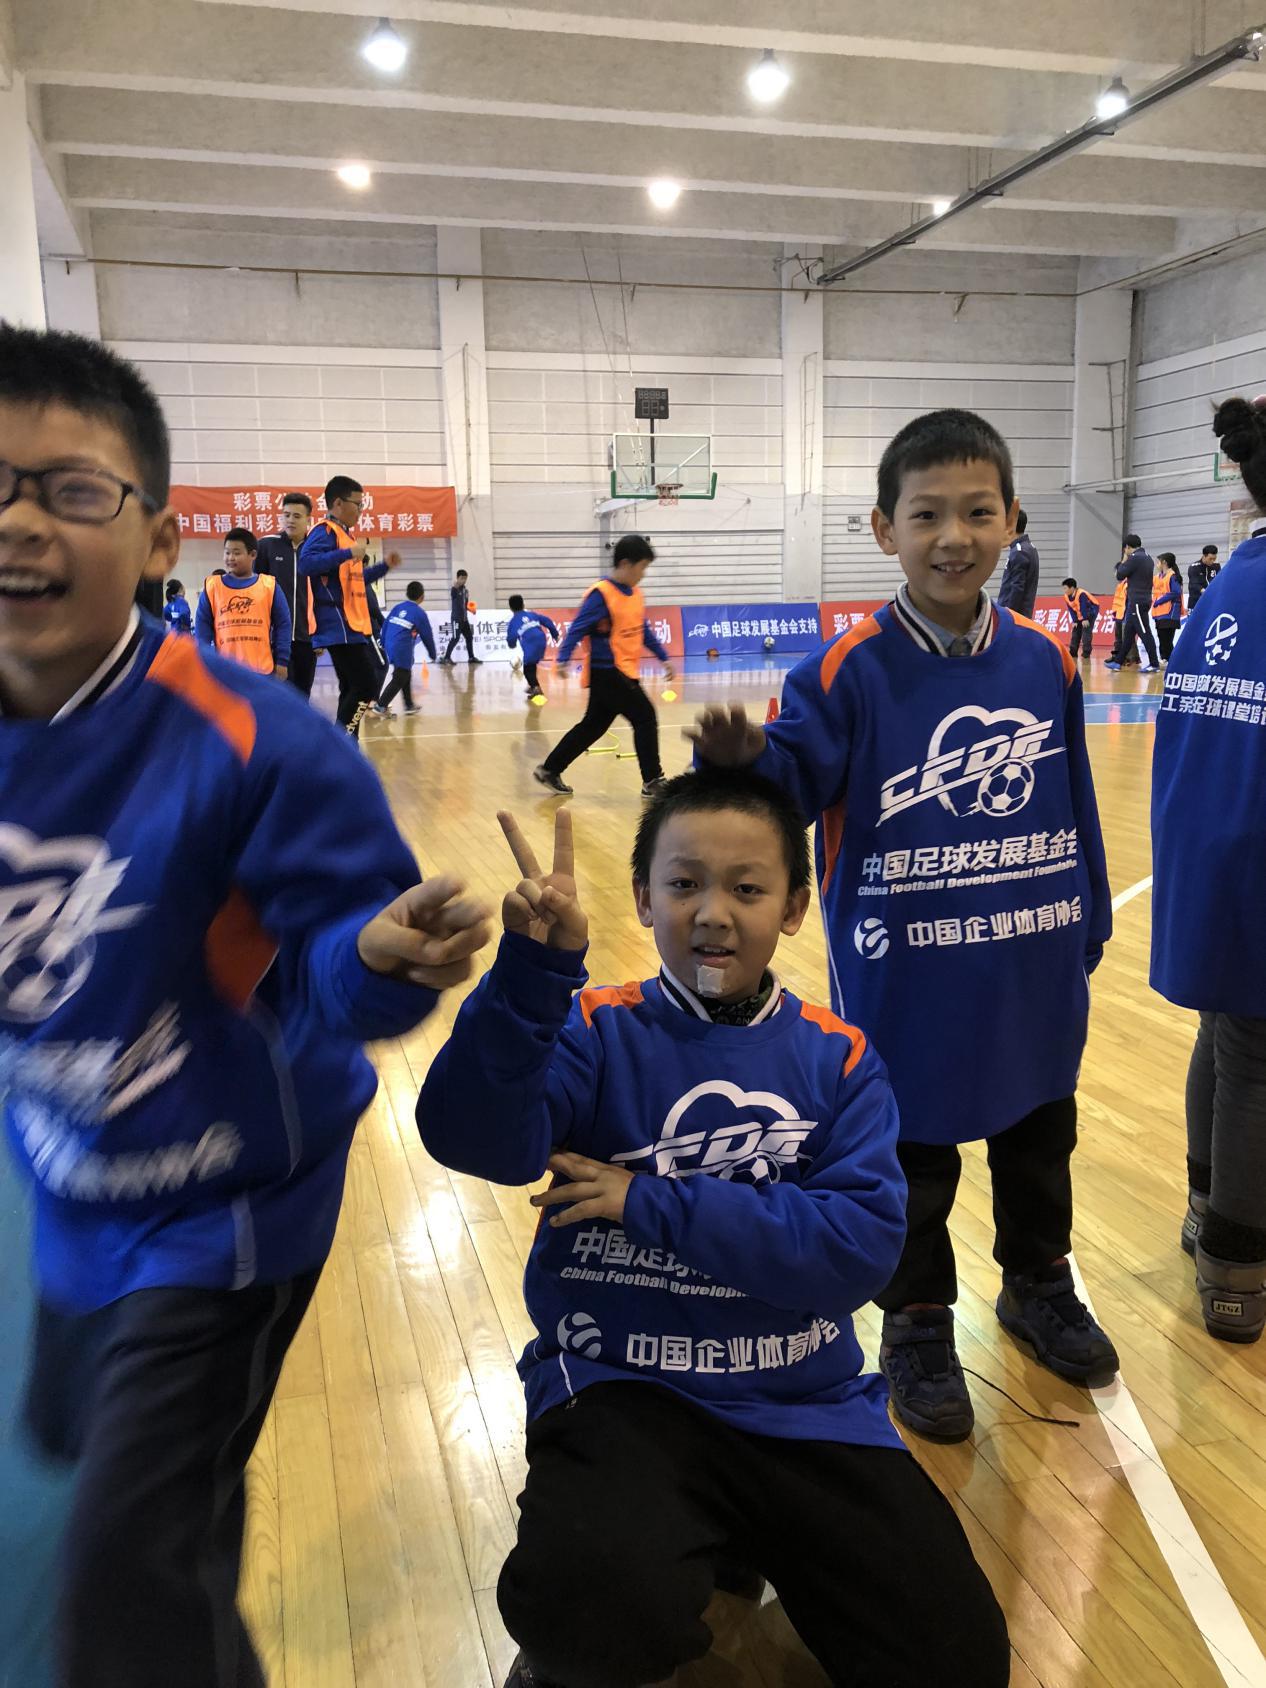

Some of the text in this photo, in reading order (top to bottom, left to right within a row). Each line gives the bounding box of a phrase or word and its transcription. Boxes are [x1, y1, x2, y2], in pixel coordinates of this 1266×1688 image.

[711, 617, 818, 638] 中国足球发展基金会支持
[862, 827, 1077, 882] 中国足球发展基金会
[858, 885, 888, 896] China
[889, 878, 944, 894] Football
[947, 868, 1034, 888] Development
[560, 1266, 603, 1283] China
